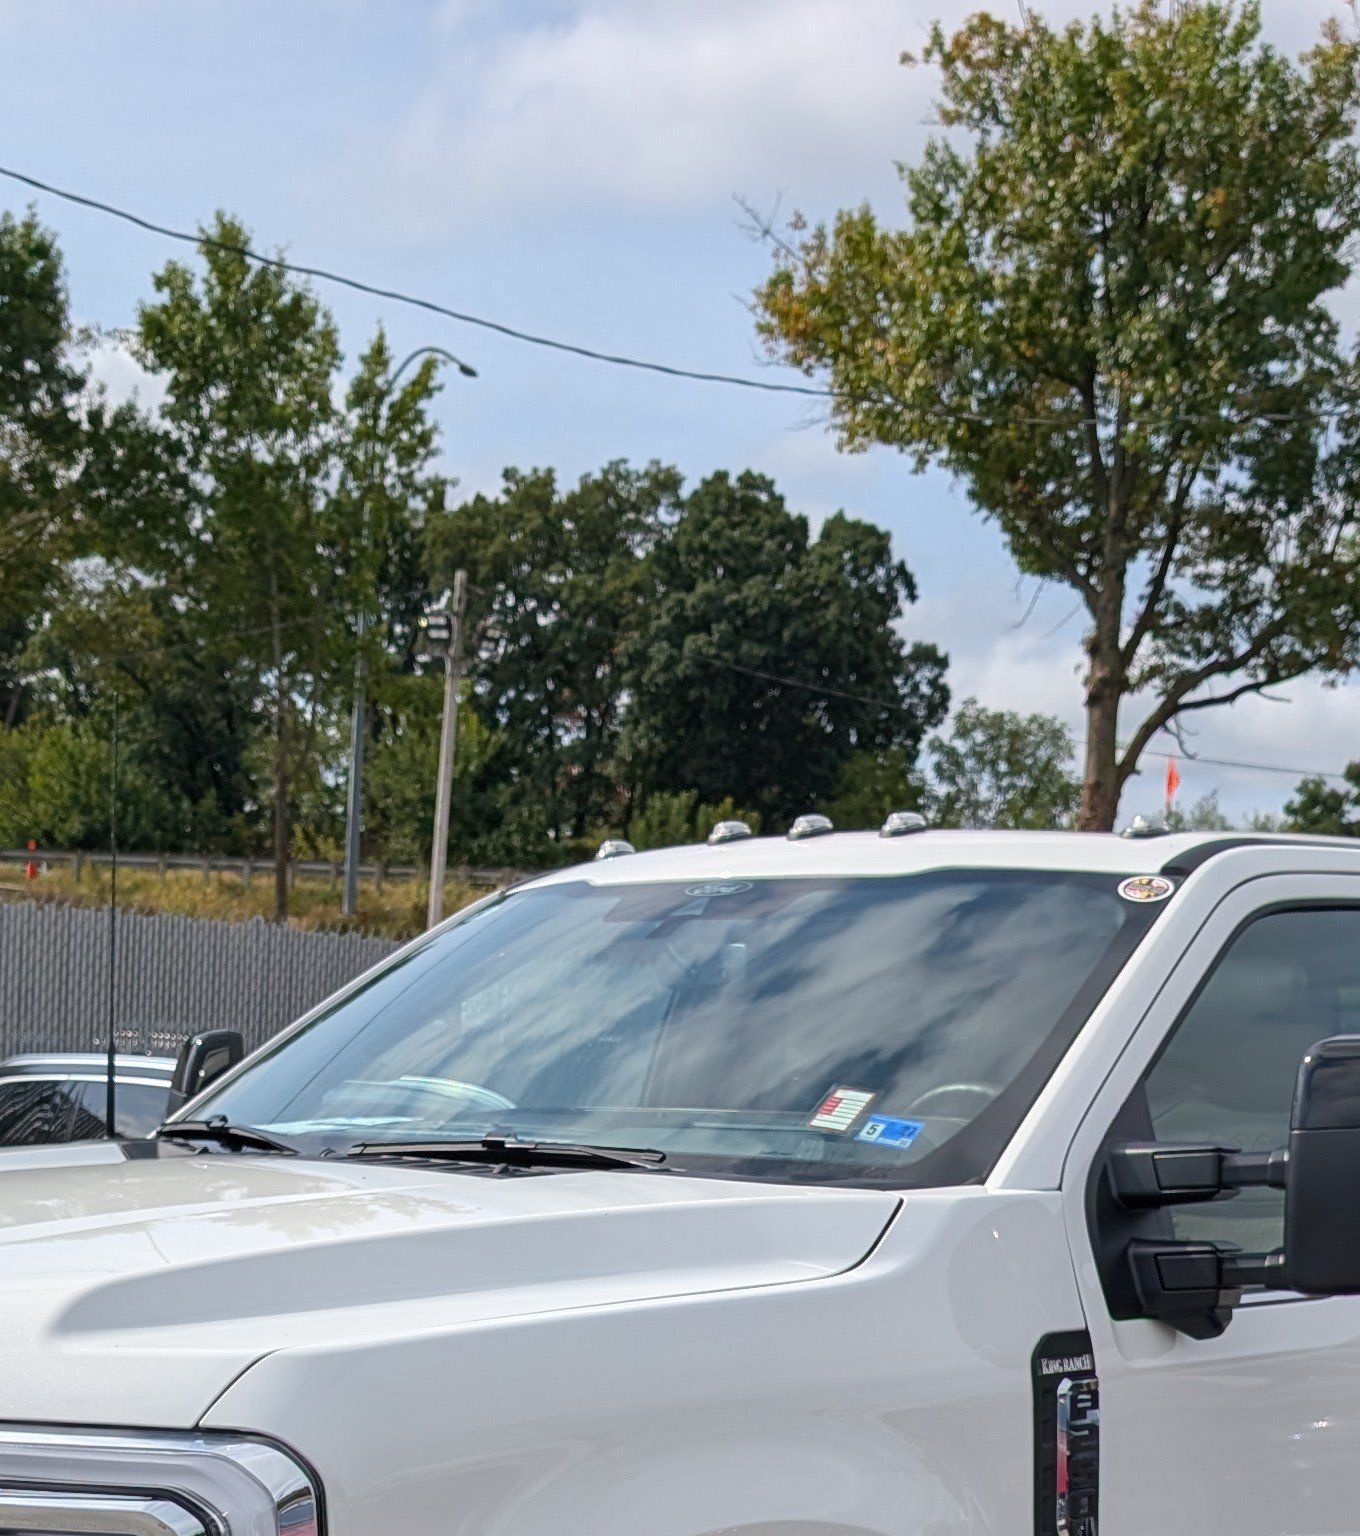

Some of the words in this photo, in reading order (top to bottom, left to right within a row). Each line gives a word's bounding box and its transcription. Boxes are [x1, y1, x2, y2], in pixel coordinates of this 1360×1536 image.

[865, 1123, 878, 1136] 5
[1041, 1358, 1062, 1375] KING
[1063, 1354, 1092, 1372] RANCH
